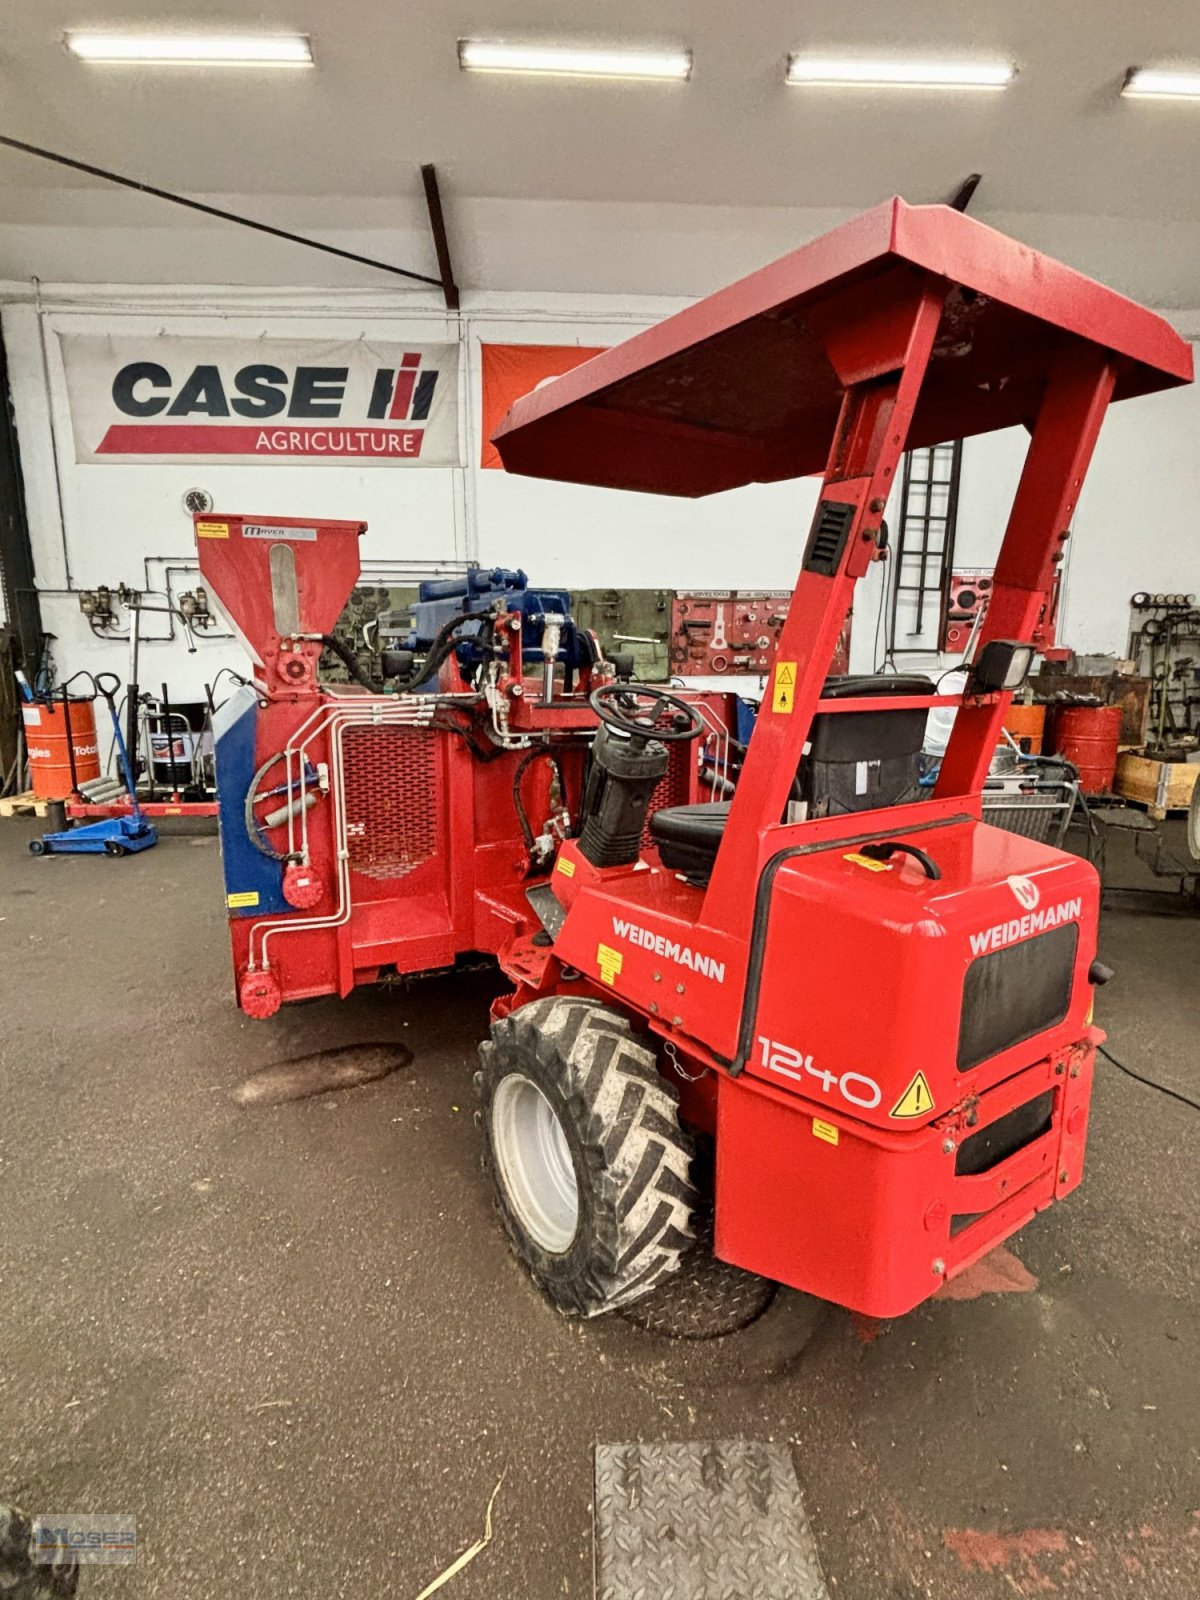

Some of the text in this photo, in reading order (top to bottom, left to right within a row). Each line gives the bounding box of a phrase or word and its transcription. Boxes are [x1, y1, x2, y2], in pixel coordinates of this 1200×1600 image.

[112, 362, 349, 418] CASE
[256, 430, 415, 453] AGRICULTURE
[612, 916, 725, 983] WEIDEMANN
[969, 897, 1082, 956] WEIDEMANN
[757, 1036, 882, 1109] 1240
